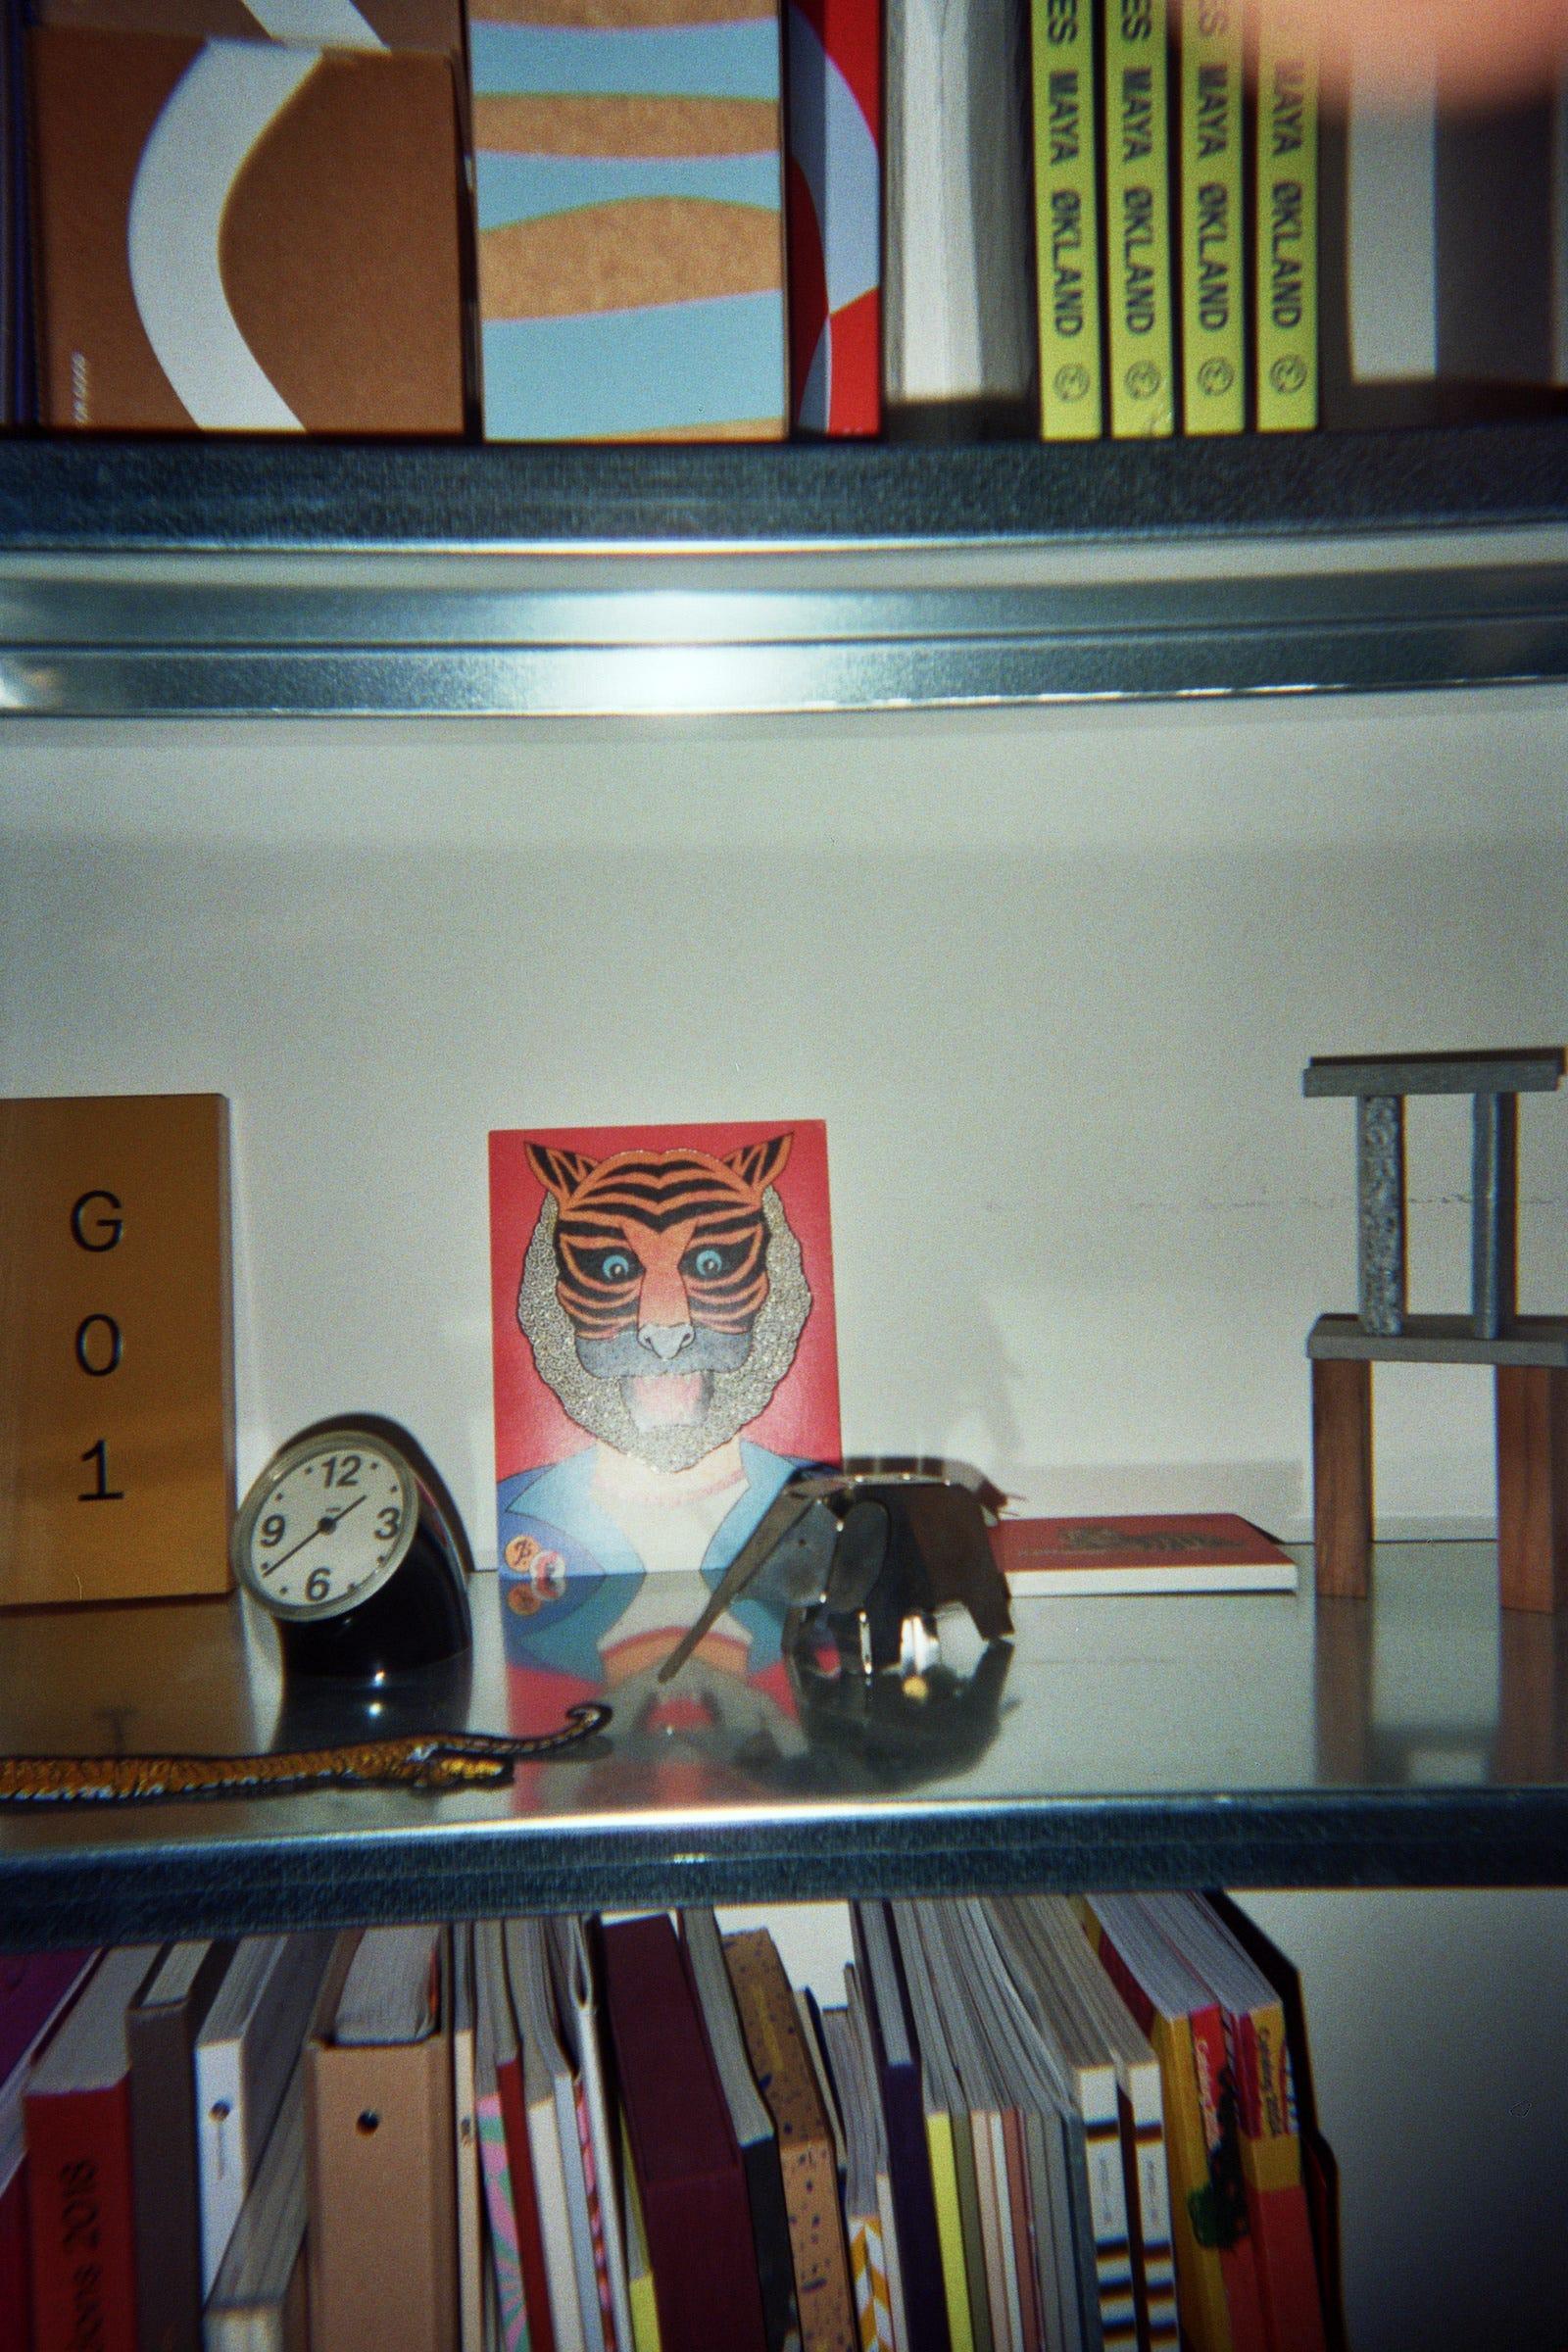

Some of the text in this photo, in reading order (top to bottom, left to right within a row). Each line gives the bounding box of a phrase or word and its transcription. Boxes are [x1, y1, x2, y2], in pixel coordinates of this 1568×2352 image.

[1049, 68, 1078, 166] MAYA
[1122, 65, 1152, 163] MAYA
[1198, 63, 1227, 159] MAYA
[1272, 59, 1303, 157] MAYA
[321, 1454, 362, 1489] 12
[260, 1513, 286, 1548] 9
[373, 1506, 401, 1541] 3
[305, 1567, 331, 1601] 6
